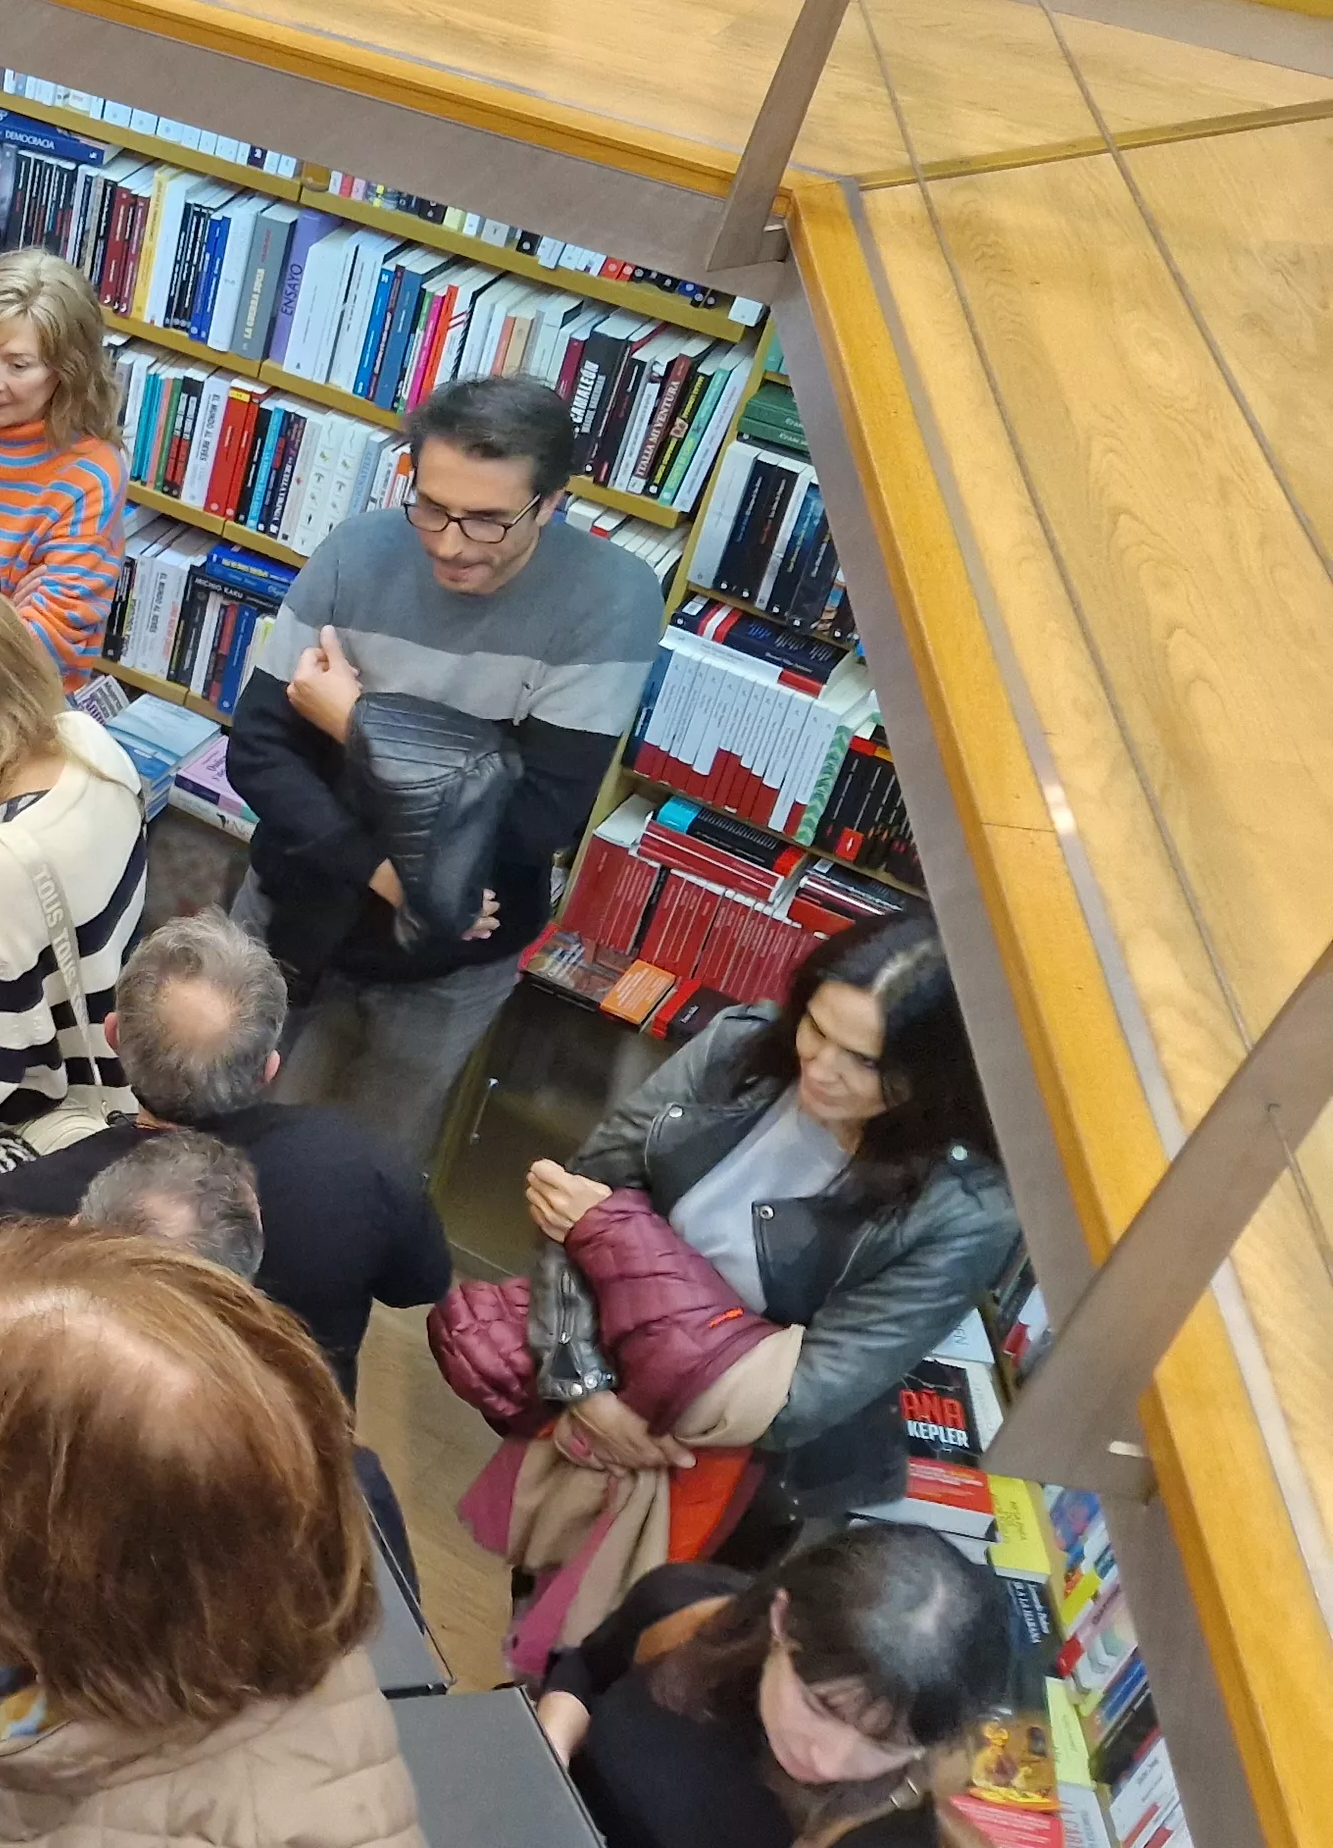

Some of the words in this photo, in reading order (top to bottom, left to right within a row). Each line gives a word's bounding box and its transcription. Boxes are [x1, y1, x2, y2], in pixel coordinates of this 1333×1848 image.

[5, 130, 55, 150] DEMOCRACIA
[280, 263, 302, 315] ENSAYO
[635, 442, 655, 476] ITALIA
[653, 379, 680, 428] VENTURA
[33, 863, 65, 929] TOUS
[52, 926, 78, 980] TOUS
[906, 1420, 970, 1448] KEPLER
